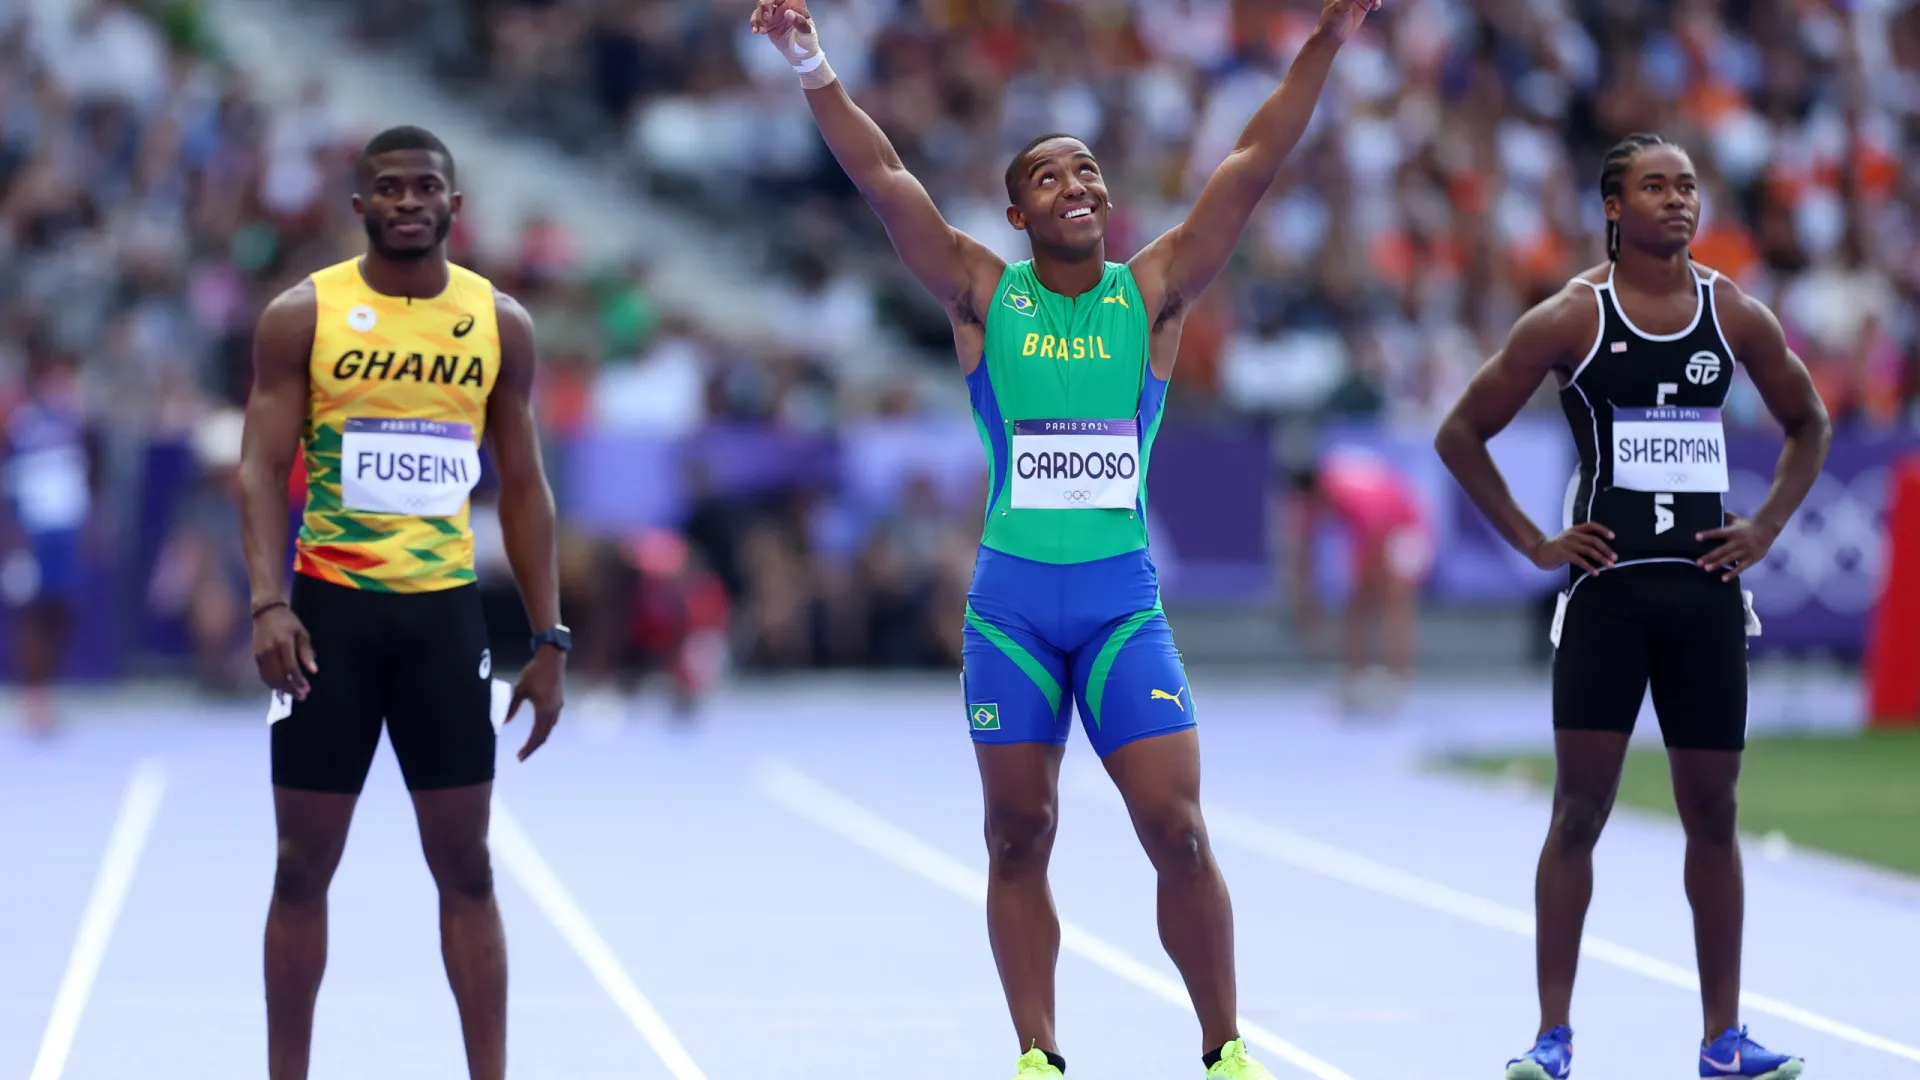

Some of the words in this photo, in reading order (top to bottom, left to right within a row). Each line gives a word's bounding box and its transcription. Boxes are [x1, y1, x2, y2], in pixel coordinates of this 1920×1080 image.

[1022, 332, 1111, 361] BRASIL
[333, 350, 484, 388] GHANA
[1045, 422, 1077, 431] PARIS
[1081, 422, 1109, 431] 2024
[1645, 410, 1676, 419] PARIS
[1618, 438, 1720, 463] SHERMAN
[357, 452, 469, 484] FUSEINI
[1016, 452, 1136, 480] CARDOSO
